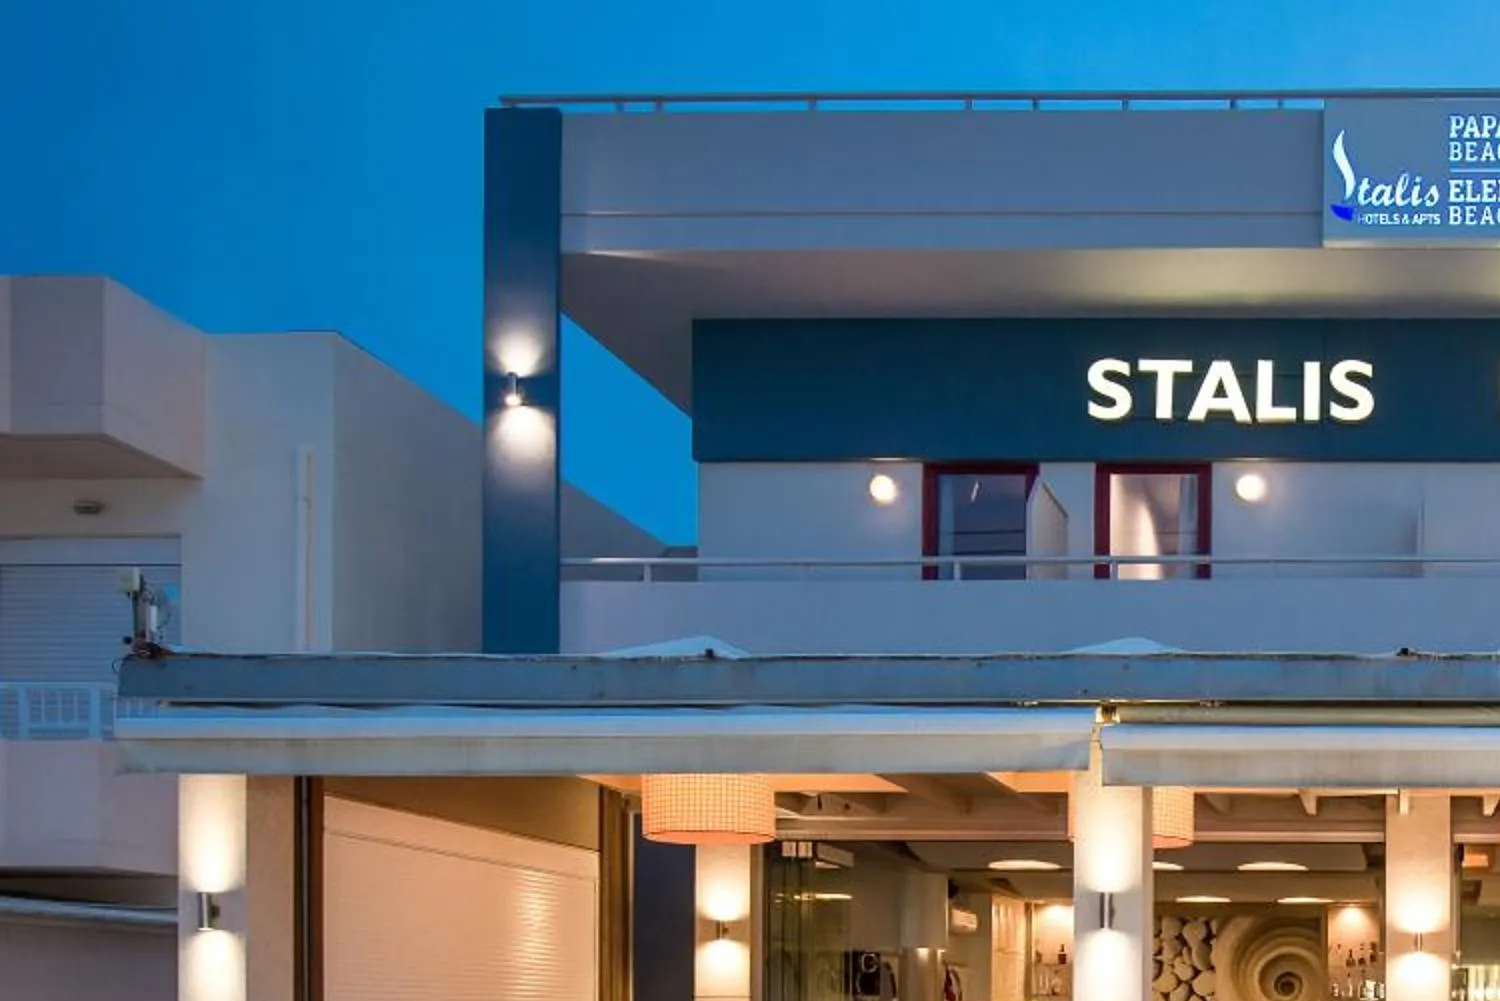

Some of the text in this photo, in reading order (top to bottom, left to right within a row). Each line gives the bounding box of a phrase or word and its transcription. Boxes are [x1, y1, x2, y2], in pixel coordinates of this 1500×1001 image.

[1330, 129, 1441, 221] Stalis
[1358, 212, 1441, 225] HOTELS & APTS
[1087, 358, 1375, 425] STALIS
